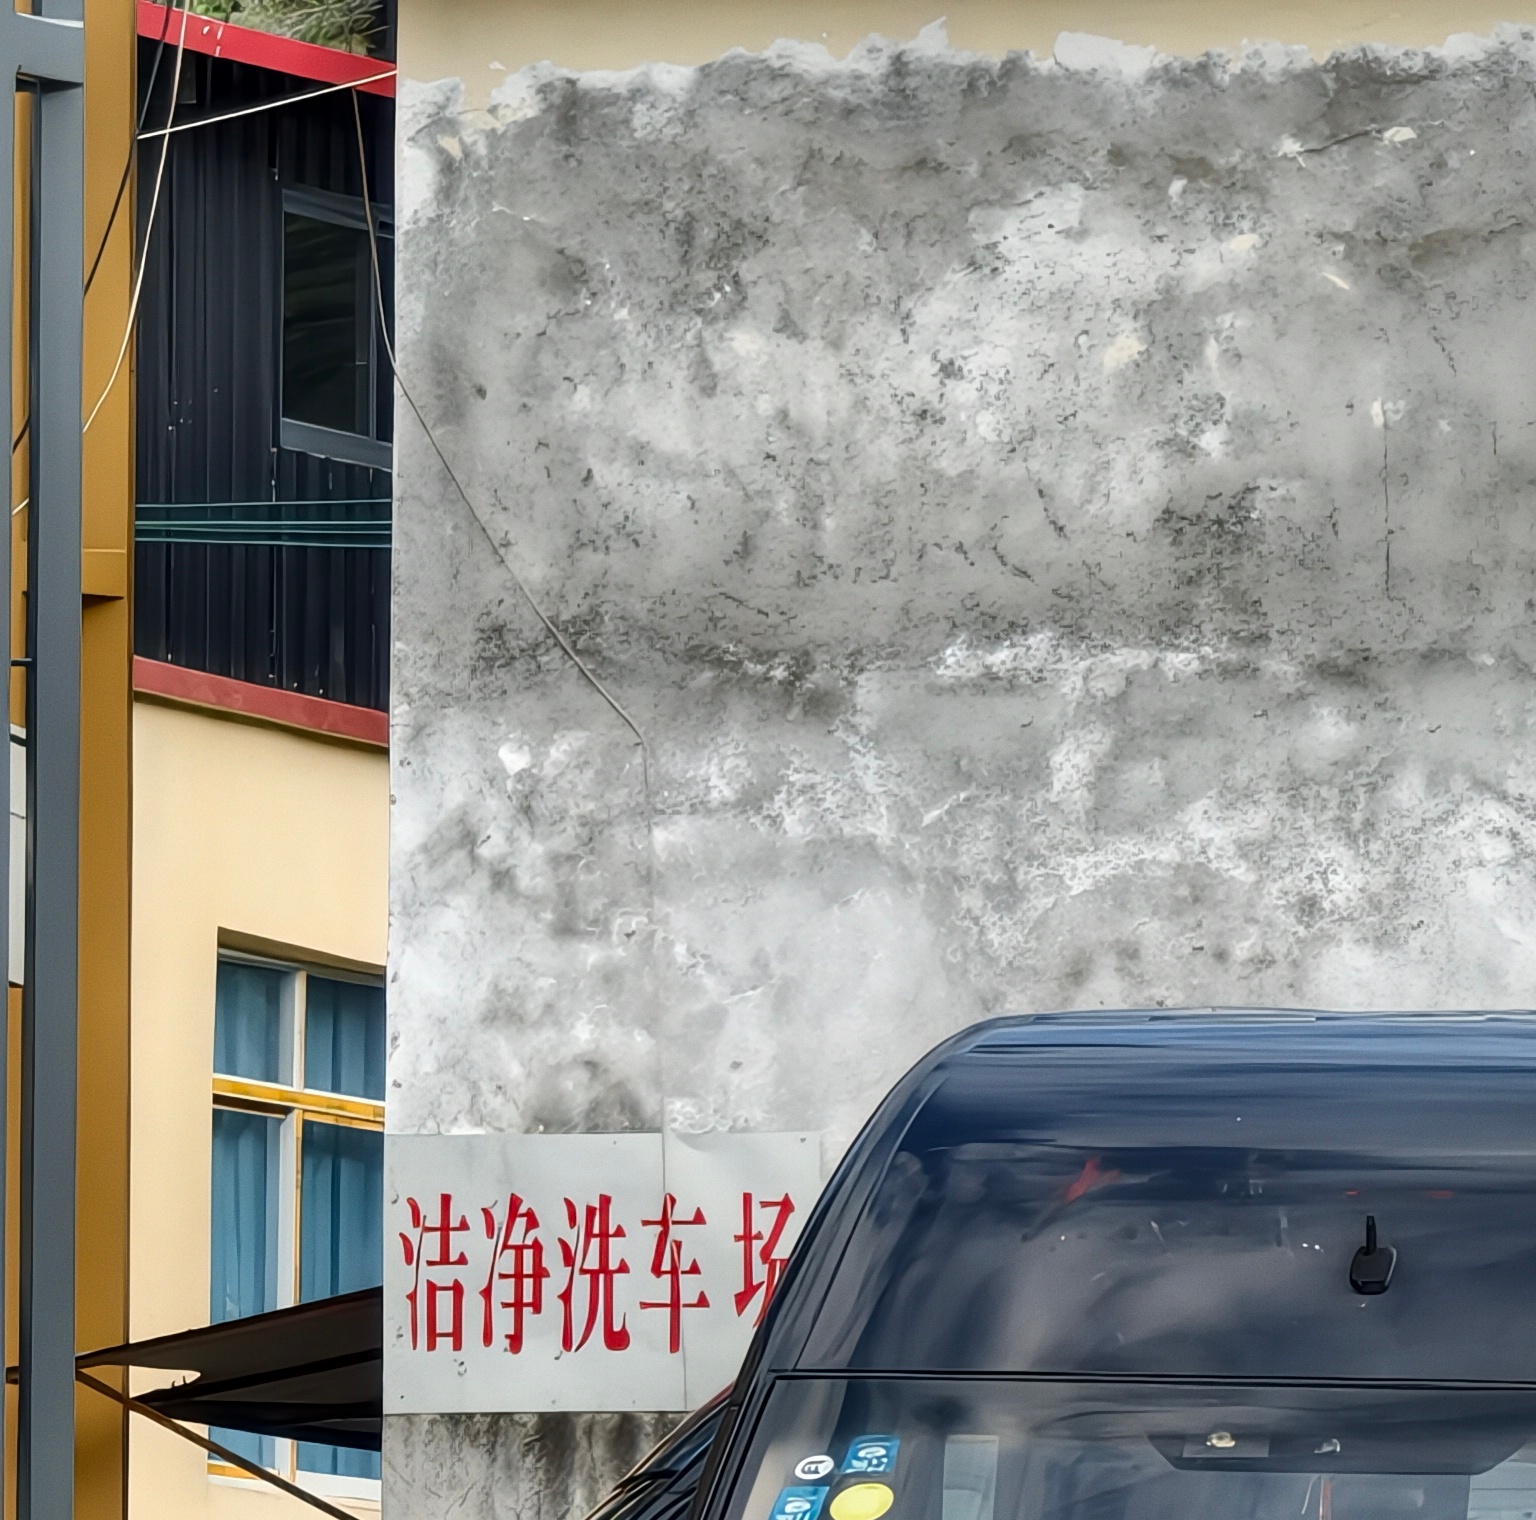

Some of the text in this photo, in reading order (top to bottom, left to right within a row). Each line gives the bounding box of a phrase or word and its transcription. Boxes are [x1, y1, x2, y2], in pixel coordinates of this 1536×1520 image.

[399, 1191, 796, 1355] 洁净洗车场
